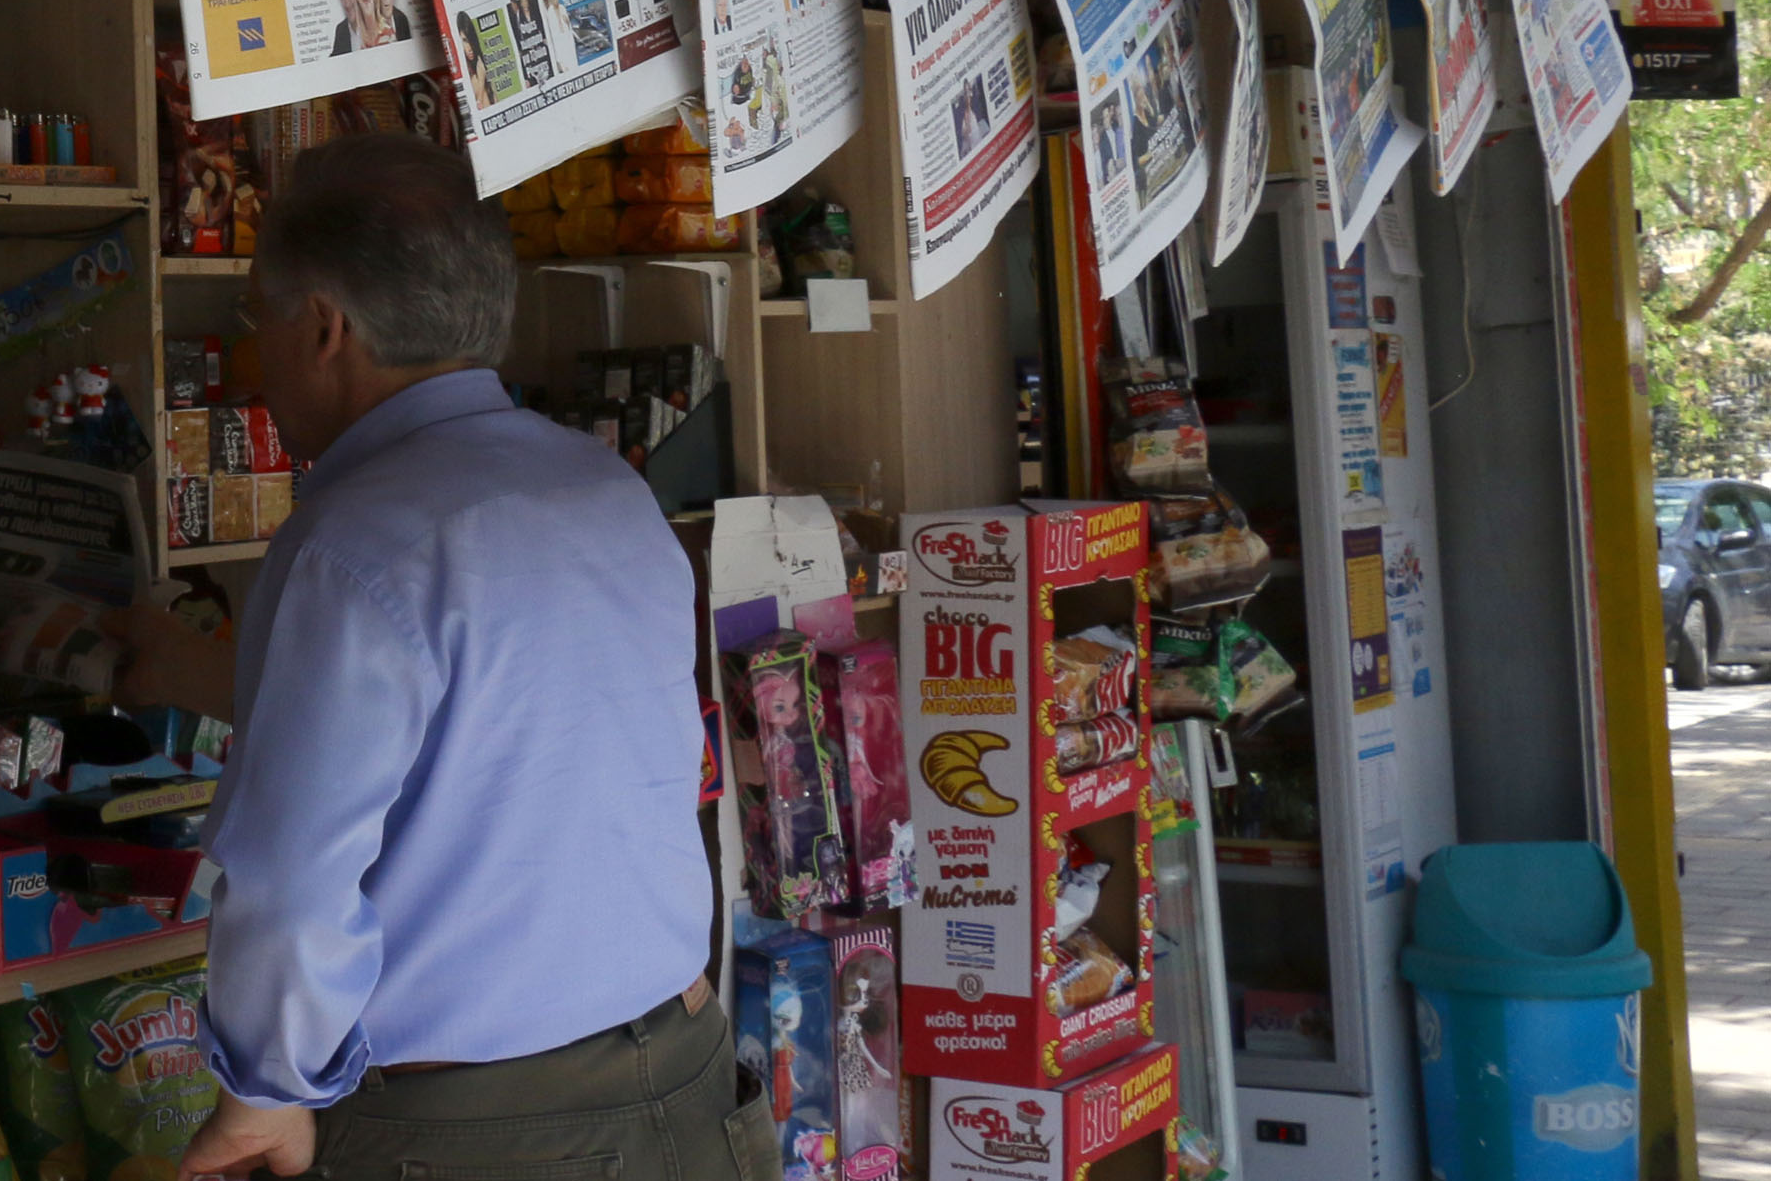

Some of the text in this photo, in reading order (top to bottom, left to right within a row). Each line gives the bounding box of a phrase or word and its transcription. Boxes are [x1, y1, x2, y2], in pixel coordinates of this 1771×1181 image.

[905, 4, 927, 57] για
[1644, 54, 1682, 68] 1517
[1044, 516, 1083, 574] BIG
[1086, 528, 1140, 564] ΚΡΟΥΑΣΑΝ
[919, 590, 1015, 602] www.freshsnack.gr
[923, 605, 990, 627] choco
[924, 623, 1014, 679] BIG
[920, 678, 1016, 697] ΓΙΓΑΝΤΙΑΙΑ
[921, 697, 1017, 716] ΑΠΟΛΑΥΣΗ
[951, 825, 995, 844] διπλή
[934, 842, 988, 858] γέμιση
[922, 885, 1018, 909] NuCrema
[925, 1010, 1017, 1030] κάθε μέρα
[1060, 991, 1137, 1038] GIANT CROISSANT
[934, 1034, 1008, 1054] φρέσκο!
[1120, 1077, 1173, 1132] ΚΡΟΥΑΣΑΝ
[1546, 1099, 1635, 1131] BOSS
[1080, 1083, 1119, 1155] BIG
